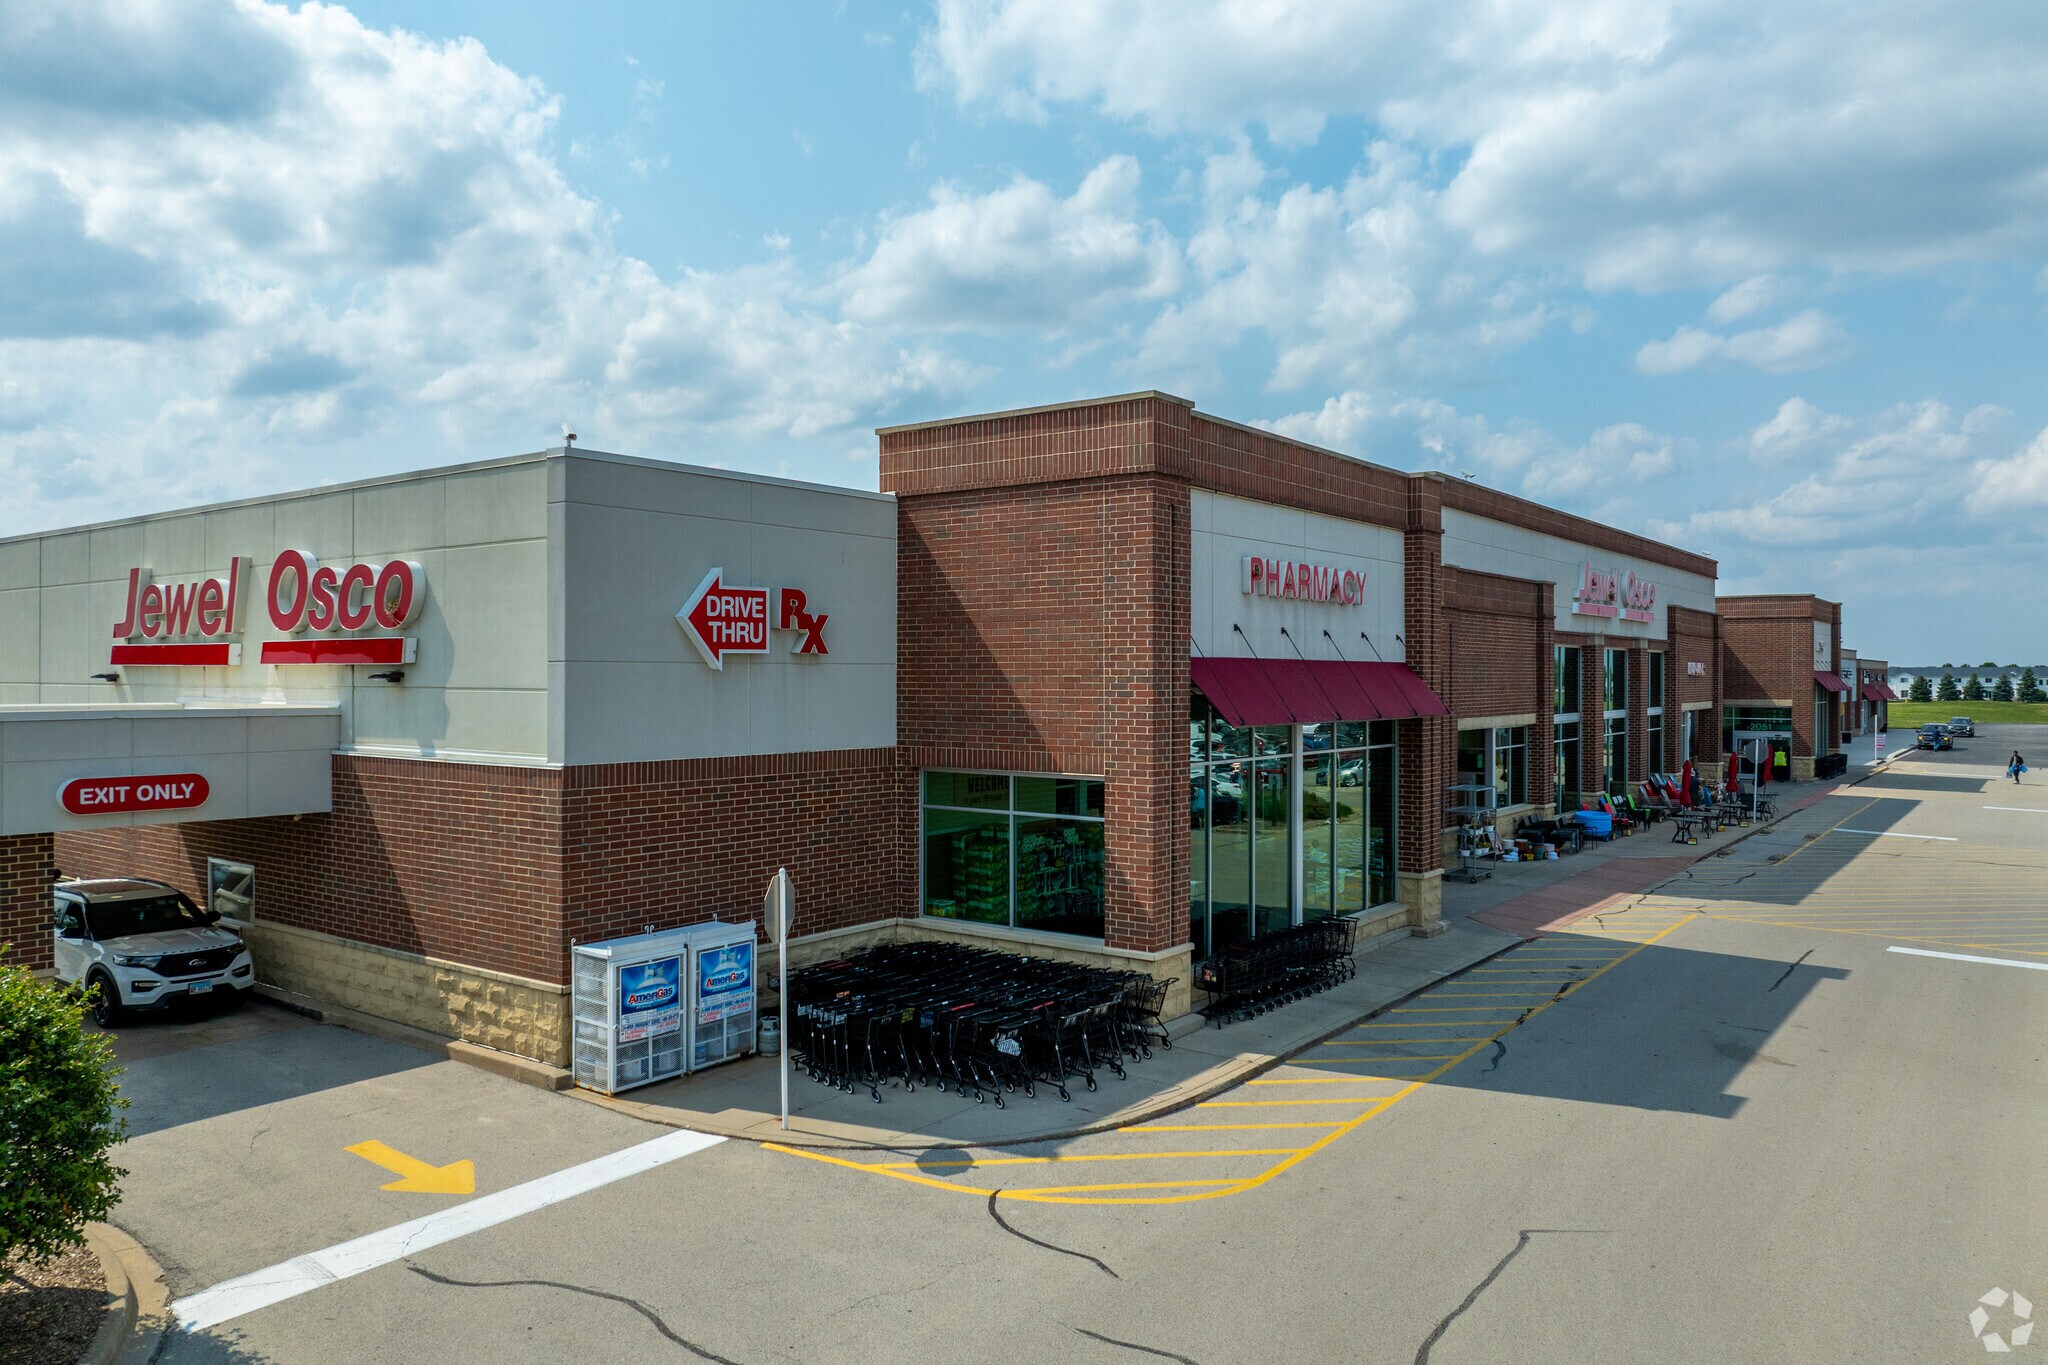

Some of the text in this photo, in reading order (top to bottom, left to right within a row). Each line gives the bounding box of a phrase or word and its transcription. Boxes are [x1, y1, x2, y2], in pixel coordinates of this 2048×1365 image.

[1249, 556, 1367, 606] PHARMACY
[1578, 560, 1656, 609] Jewel Osco
[113, 549, 418, 639] Jewel Osco
[706, 595, 764, 618] DRIVE
[707, 621, 764, 643] THRU
[1750, 722, 1772, 731] 2051
[79, 782, 195, 805] EXIT ONLY
[968, 775, 1010, 793] WELCOME
[706, 972, 745, 987] AmeriGas
[629, 987, 673, 1004] AmeriGas
